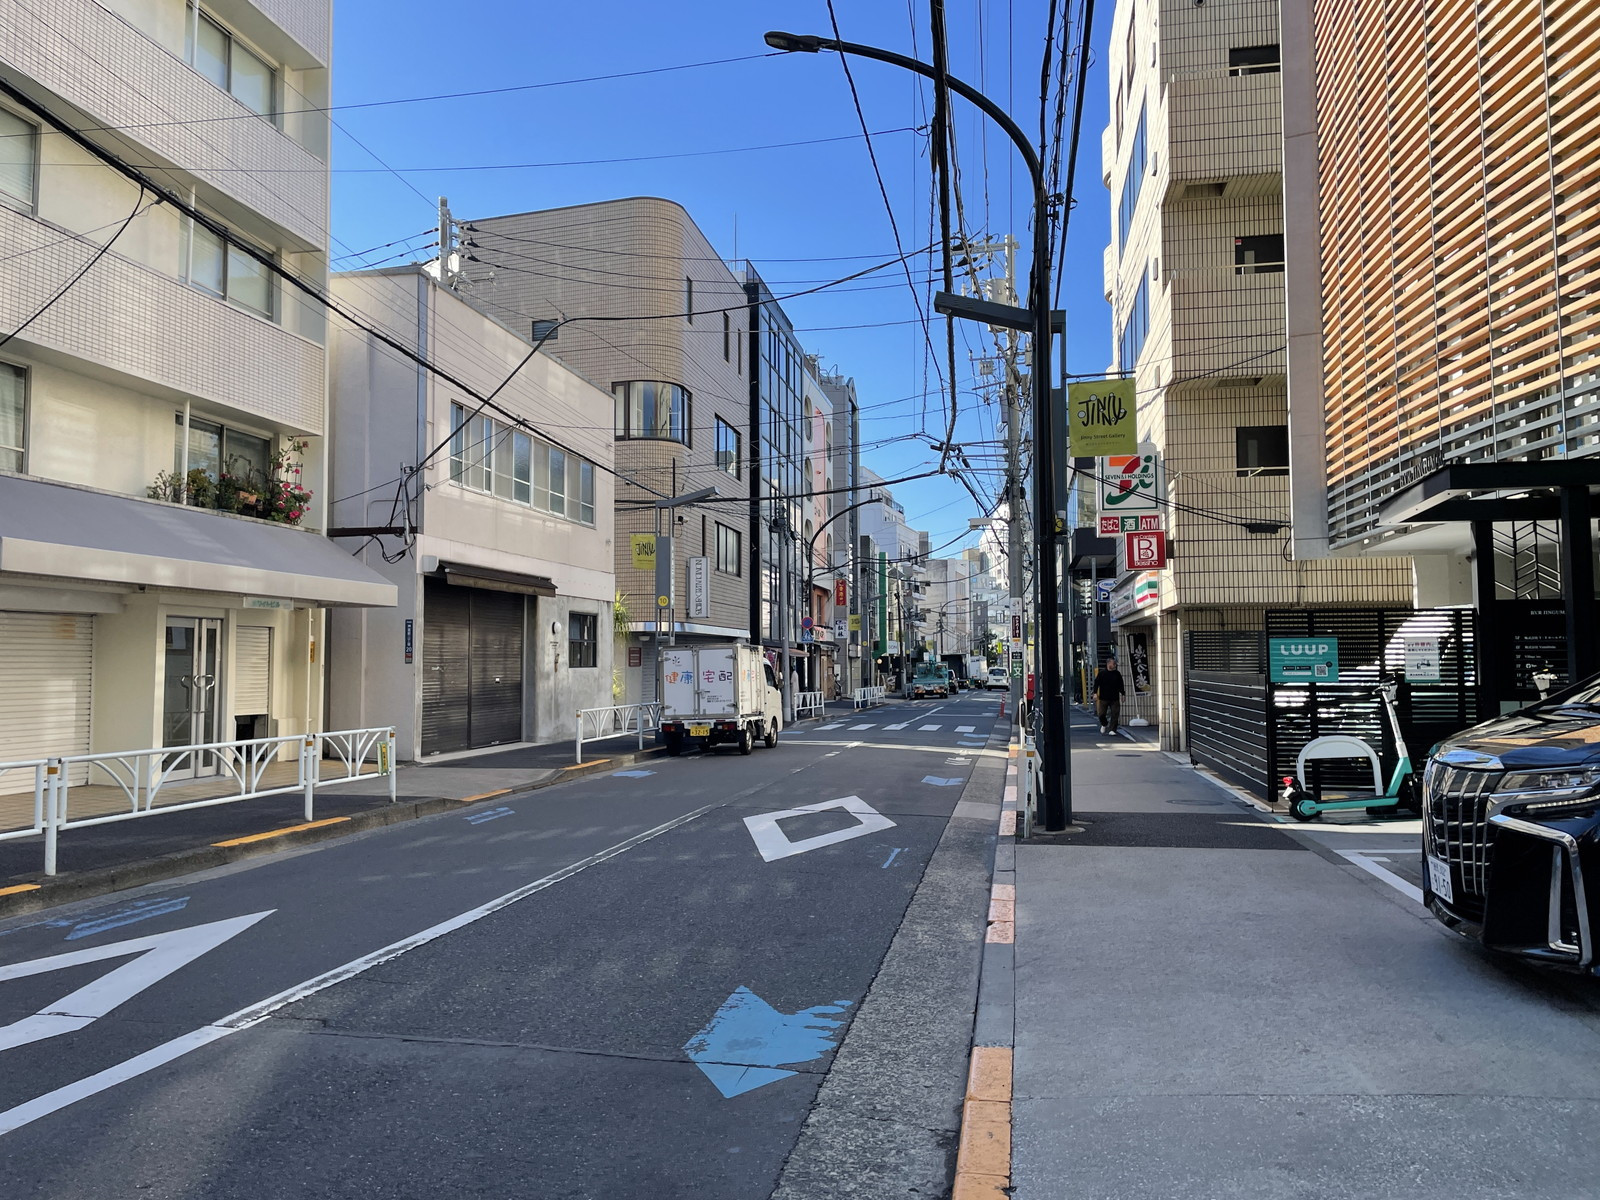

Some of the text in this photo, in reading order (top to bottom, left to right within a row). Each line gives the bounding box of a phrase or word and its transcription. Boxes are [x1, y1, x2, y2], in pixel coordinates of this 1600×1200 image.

[1127, 472, 1155, 480] HOLDINGS
[1101, 519, 1119, 531] たばこ
[1123, 518, 1136, 531] 酒
[1141, 517, 1160, 530] ATM
[1137, 539, 1155, 560] B
[1101, 592, 1108, 600] P
[1280, 644, 1329, 656] LUUP
[665, 669, 733, 684] 健康宅配
